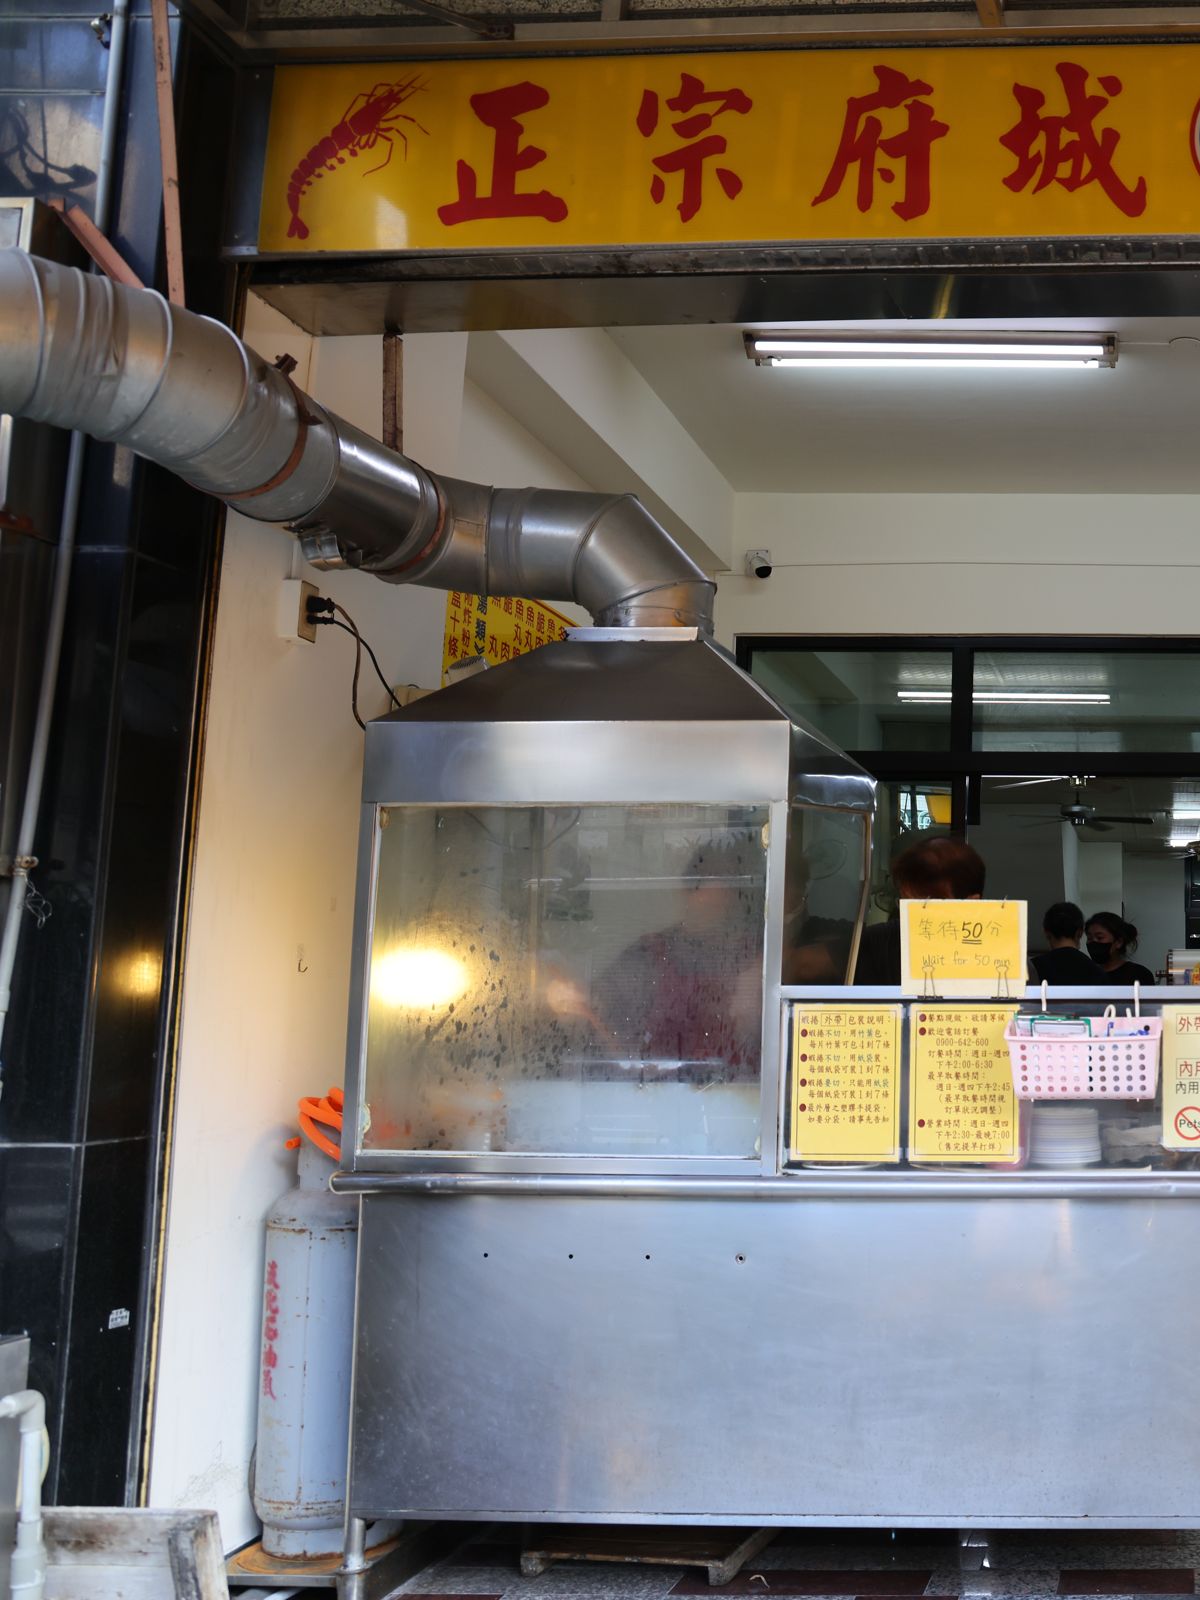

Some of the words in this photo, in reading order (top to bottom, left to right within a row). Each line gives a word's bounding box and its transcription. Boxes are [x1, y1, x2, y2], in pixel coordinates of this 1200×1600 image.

[919, 918, 1003, 941] 等待50分
[953, 950, 968, 965] for
[974, 954, 990, 966] 50
[824, 1015, 842, 1025] 外帶
